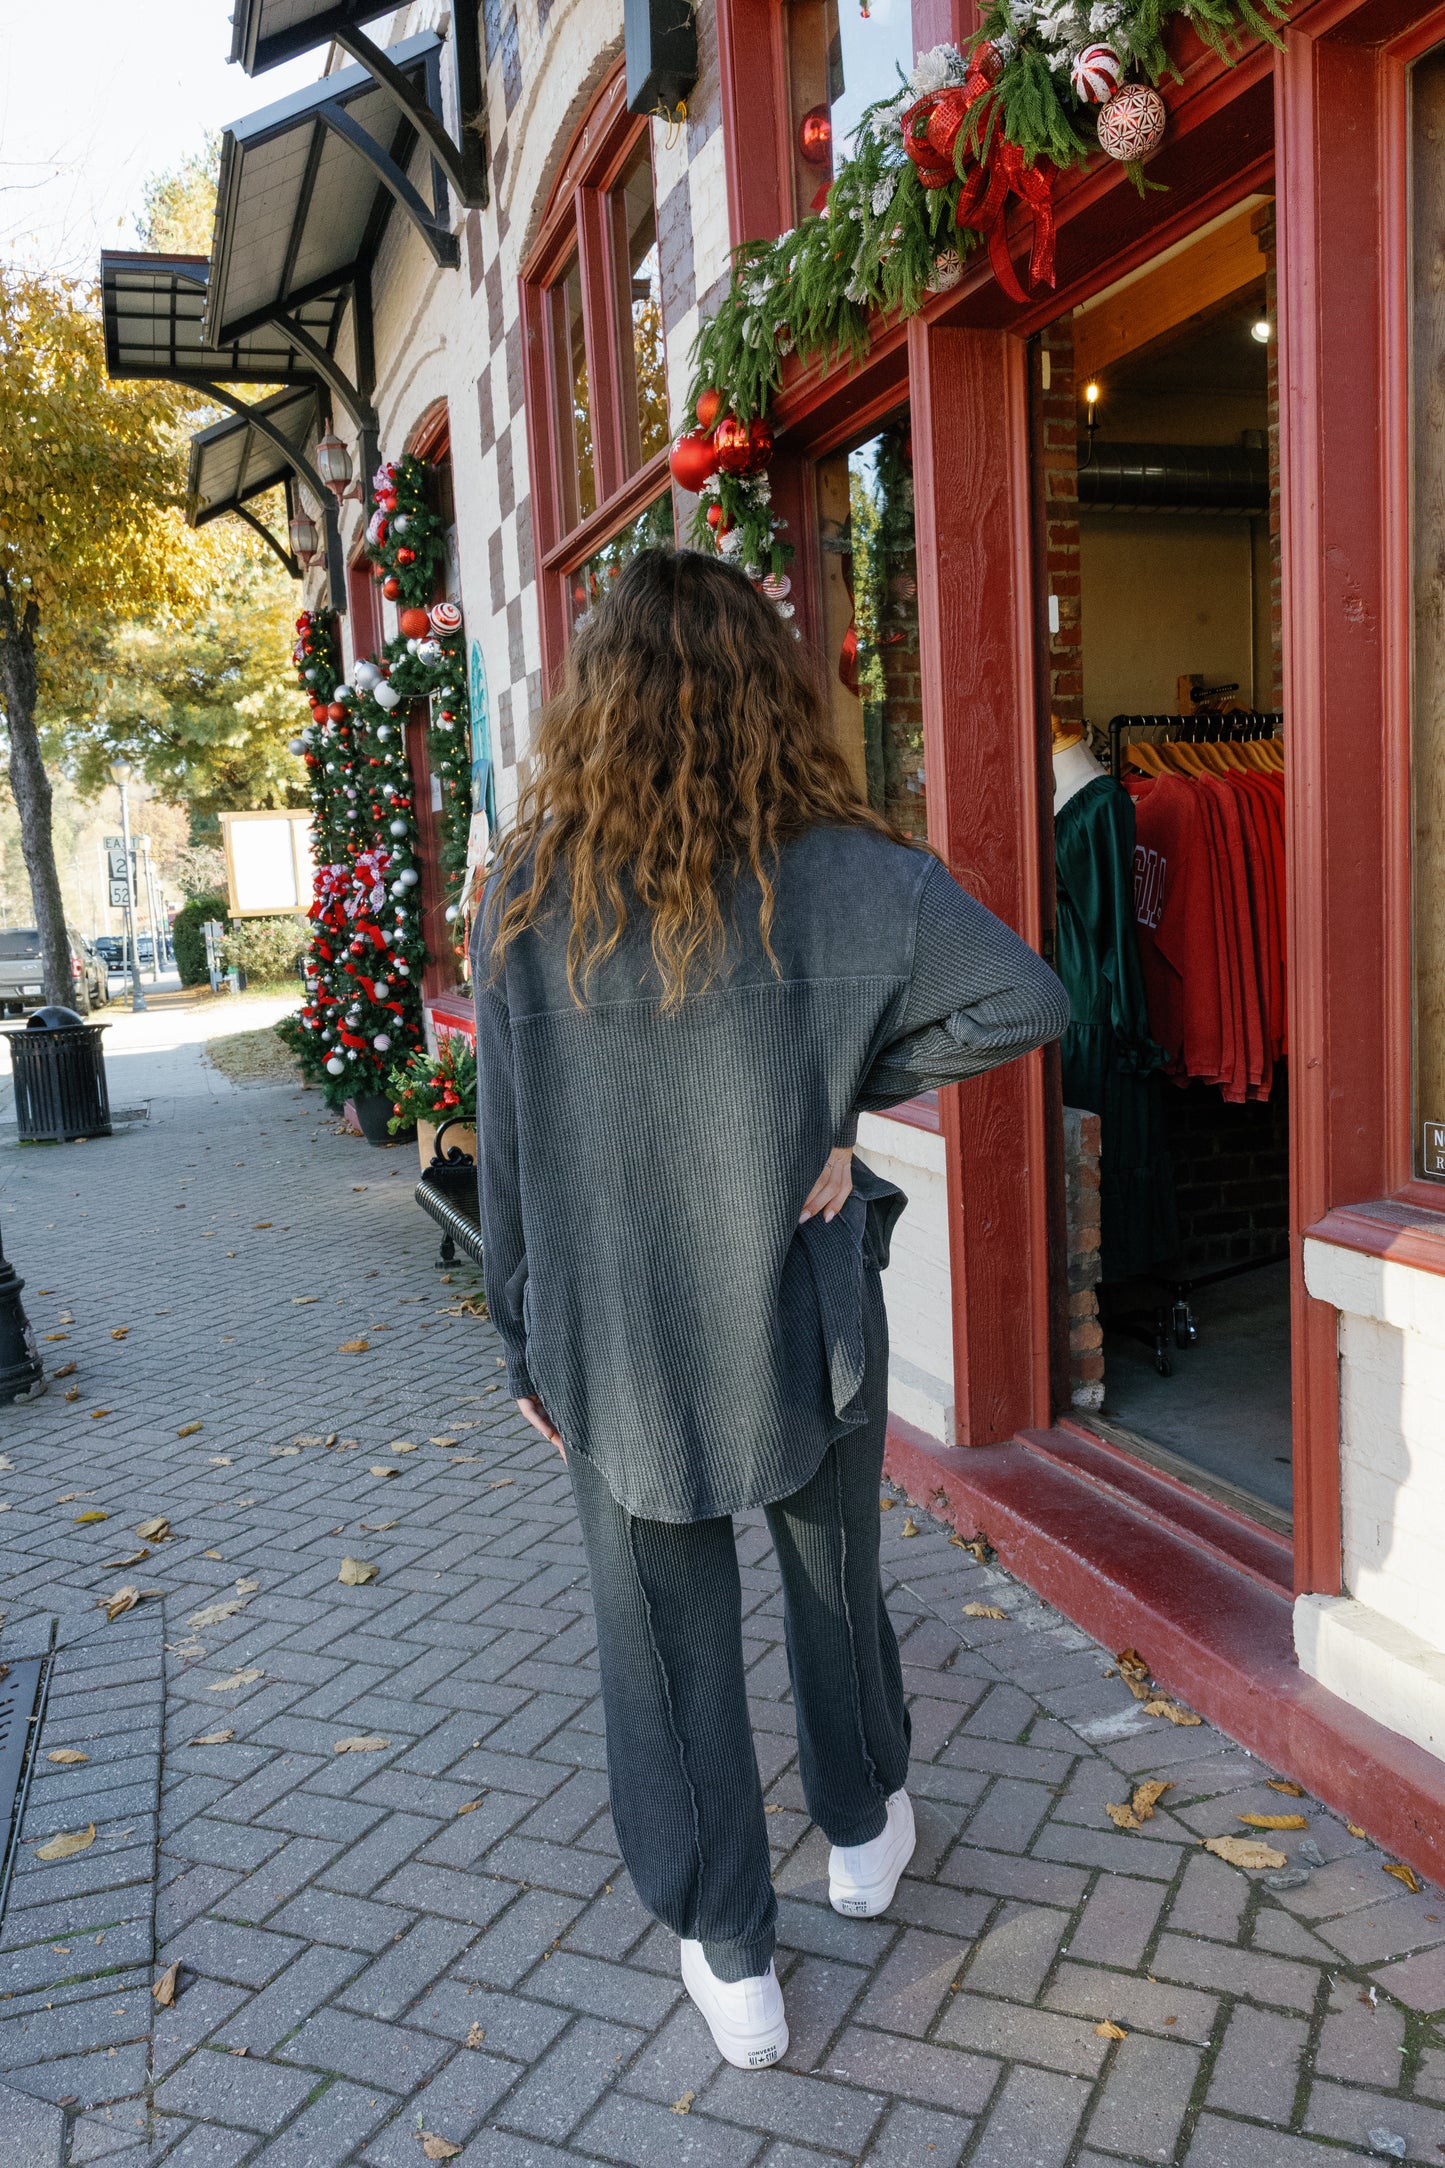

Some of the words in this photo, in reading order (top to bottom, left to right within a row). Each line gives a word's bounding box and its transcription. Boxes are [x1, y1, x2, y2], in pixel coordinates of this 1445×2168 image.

[105, 838, 137, 849] EAT
[116, 858, 128, 873] 2
[114, 888, 129, 903] 52
[1434, 1129, 1445, 1147] N
[748, 2045, 776, 2056] CONVERSE
